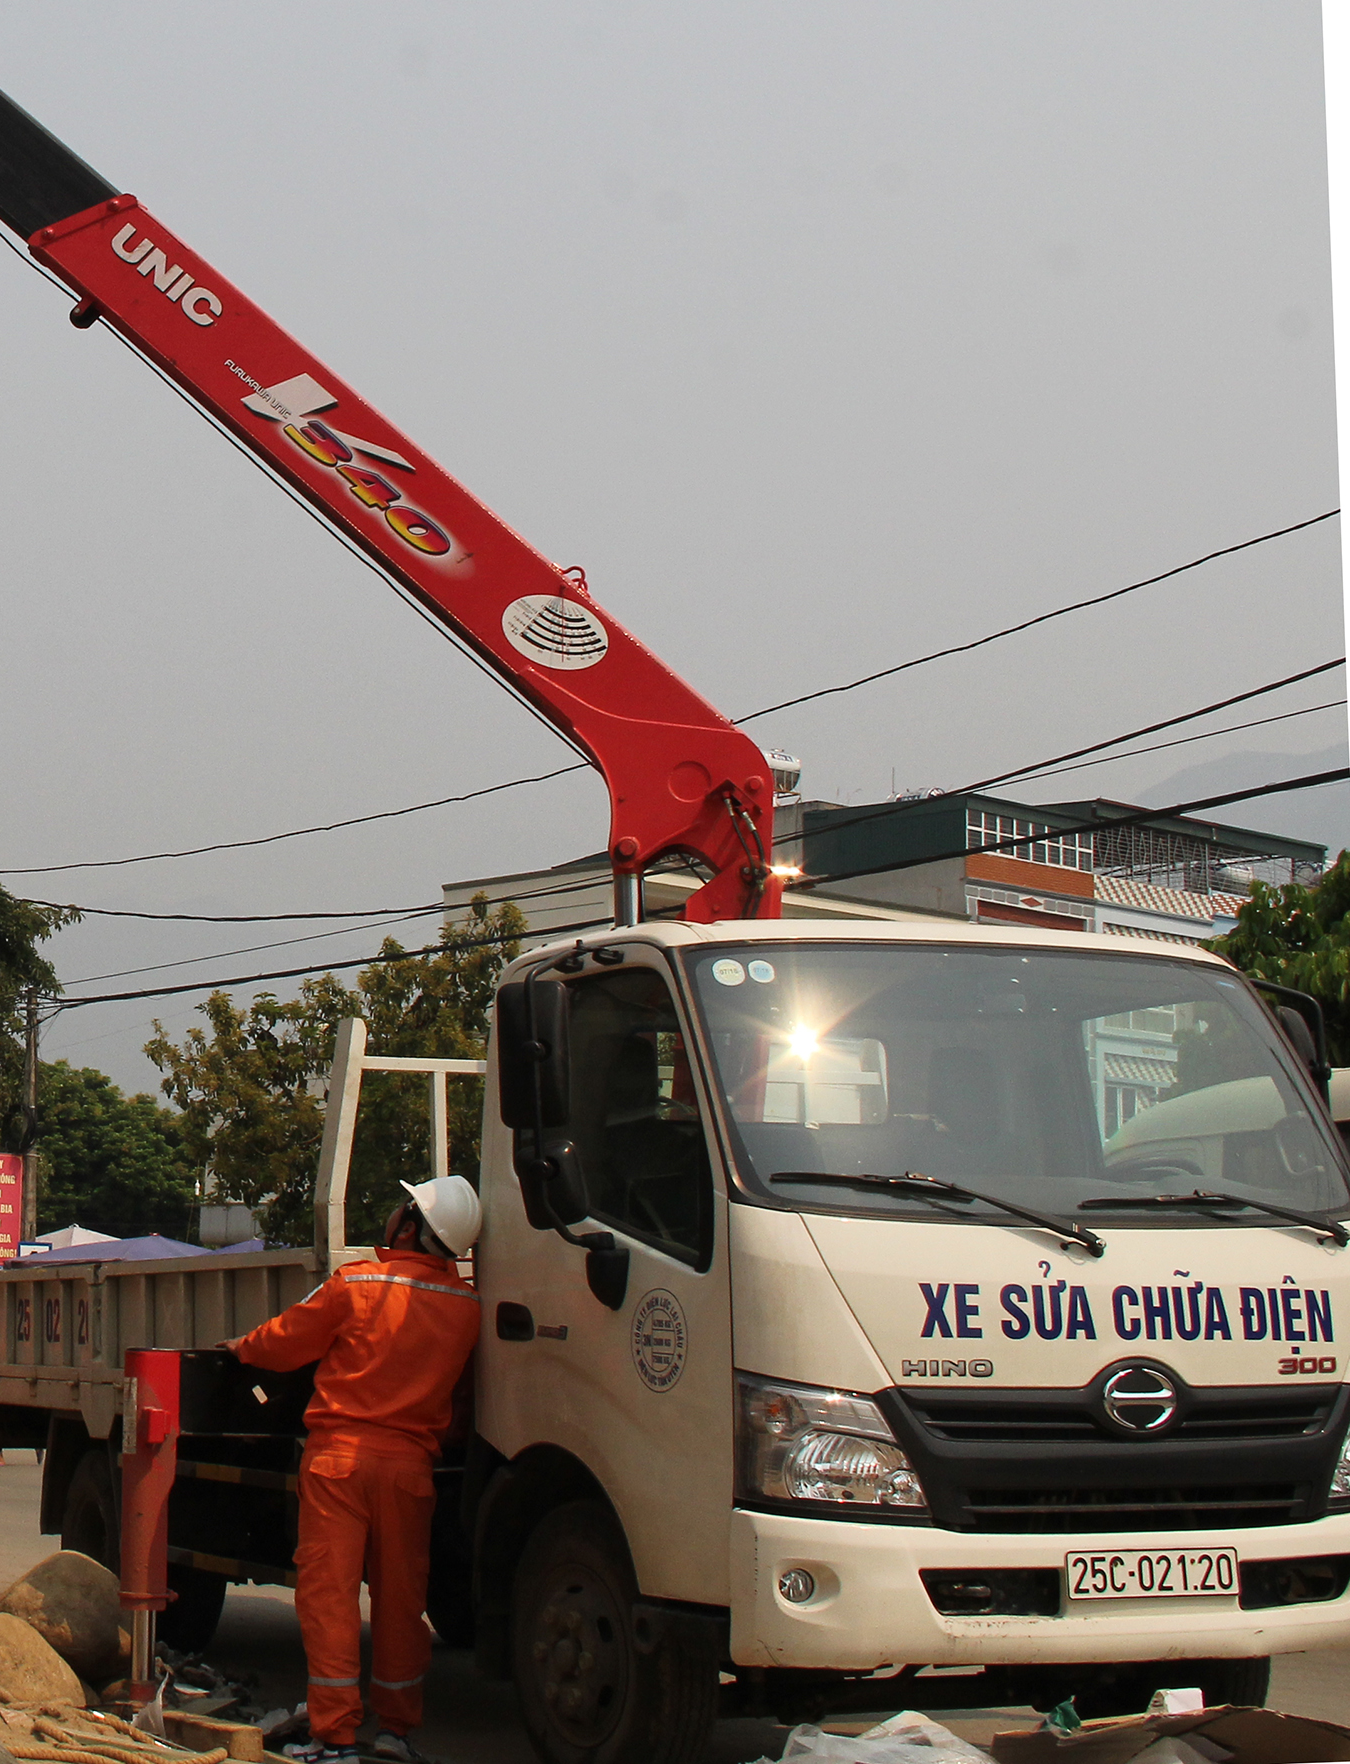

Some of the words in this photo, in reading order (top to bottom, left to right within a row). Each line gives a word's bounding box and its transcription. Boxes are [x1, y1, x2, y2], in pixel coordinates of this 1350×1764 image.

[111, 222, 223, 327] UNIC
[223, 358, 272, 404] FURUKAWA
[270, 397, 293, 420] UNIC
[282, 419, 451, 556] 340
[0, 1204, 13, 1214] BIA
[17, 1298, 30, 1341] 25
[46, 1298, 60, 1342] 02
[918, 1281, 983, 1340] XE
[999, 1260, 1098, 1341] SỬA
[1111, 1268, 1233, 1342] CHỮA
[1238, 1275, 1336, 1355] ĐIỆN
[901, 1358, 995, 1378] HINO
[1277, 1356, 1337, 1375] 300
